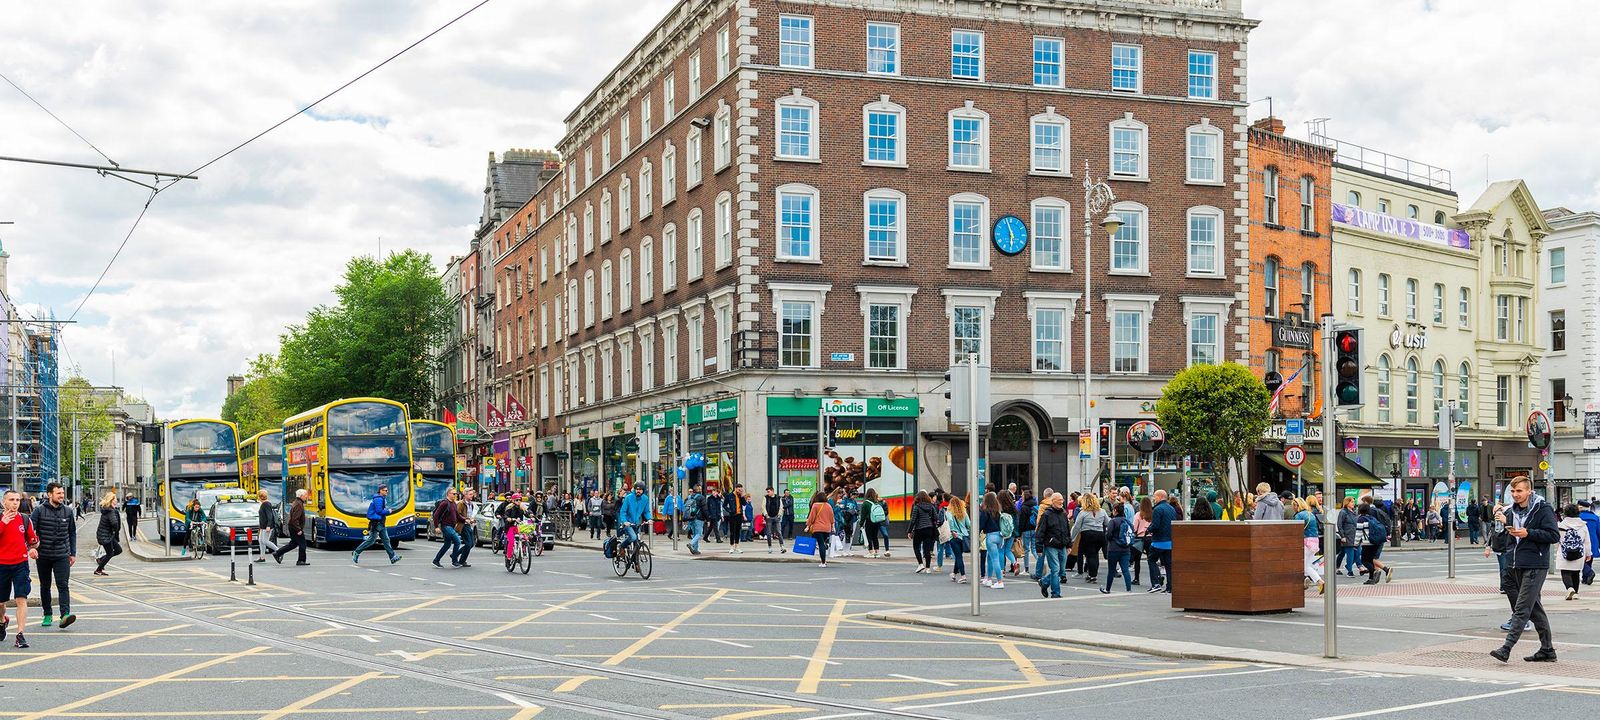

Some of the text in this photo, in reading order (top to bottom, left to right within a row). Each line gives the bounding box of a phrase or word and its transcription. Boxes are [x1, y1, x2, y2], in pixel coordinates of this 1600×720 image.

[1357, 209, 1379, 231] CAMP
[1382, 214, 1399, 236] USA
[1279, 327, 1309, 344] GUINNESS
[825, 402, 863, 413] Londis
[1150, 430, 1159, 438] 30
[1290, 451, 1301, 460] 30
[1409, 469, 1420, 477] USIT
